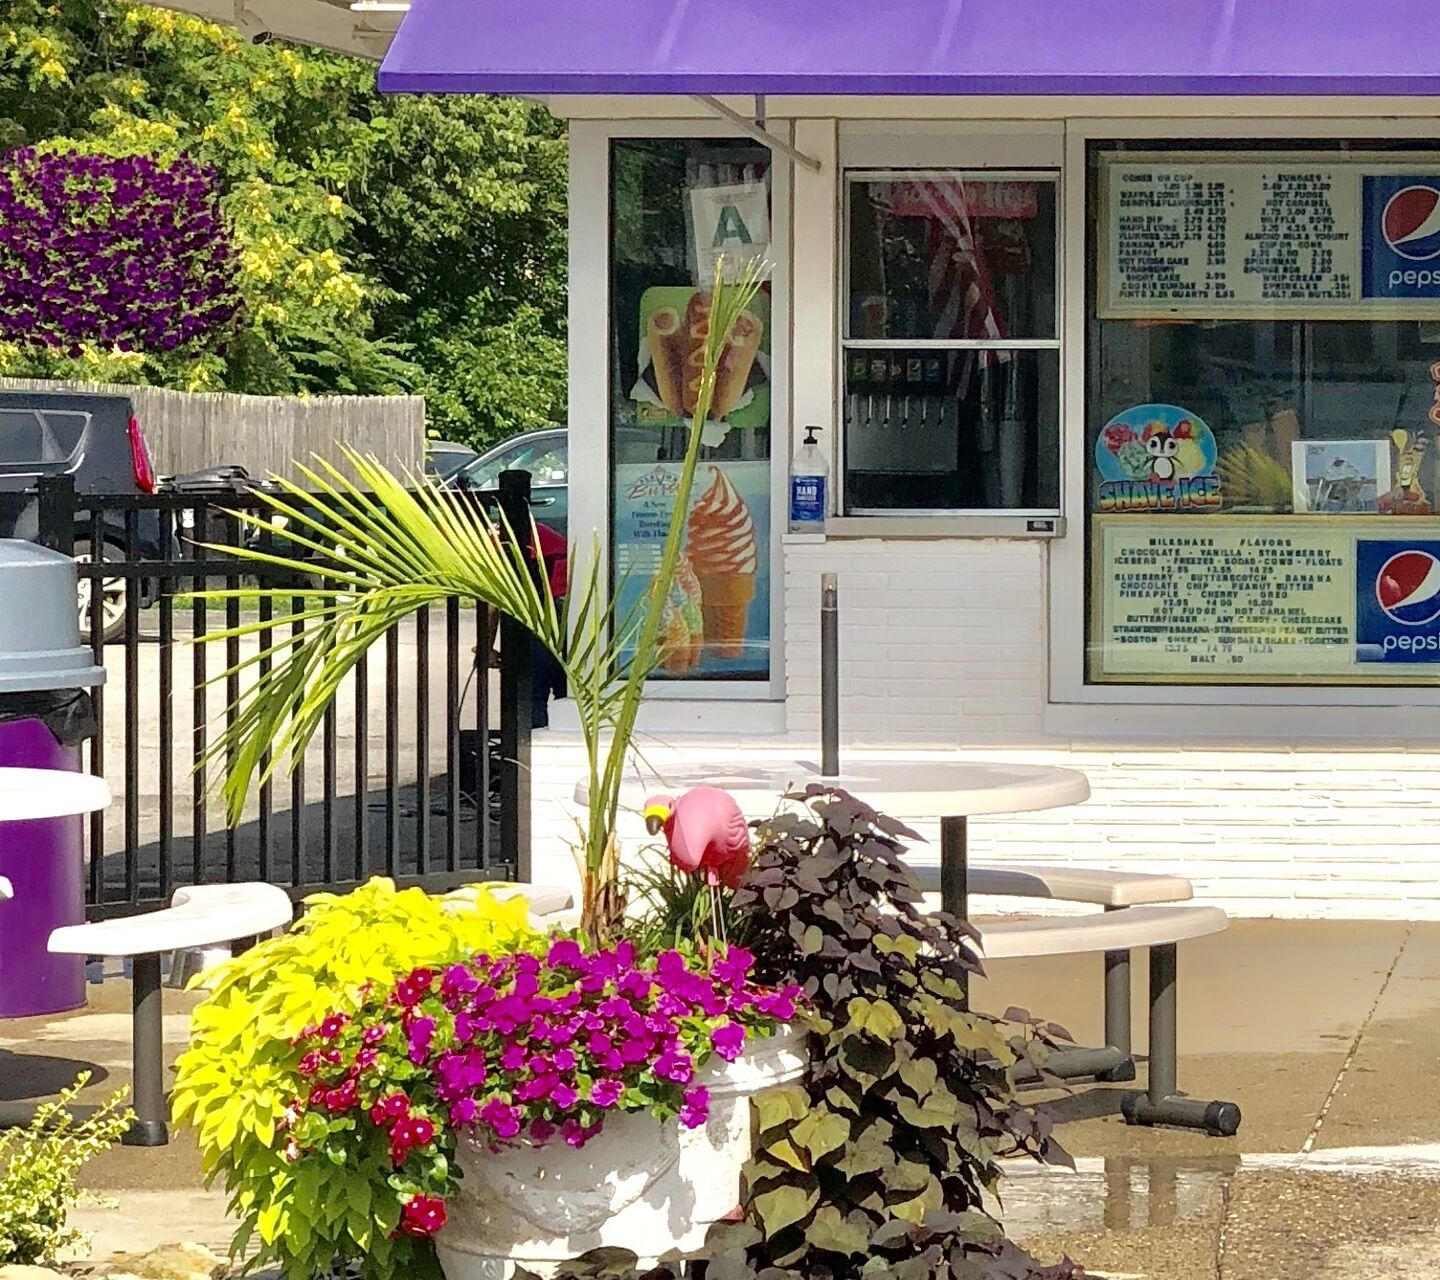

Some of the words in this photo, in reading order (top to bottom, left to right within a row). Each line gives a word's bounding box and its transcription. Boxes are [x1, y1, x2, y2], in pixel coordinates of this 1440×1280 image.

[712, 206, 753, 248] A
[1099, 480, 1176, 511] SHAVE
[1178, 476, 1222, 508] ICE
[1149, 538, 1214, 546] MILKSHAKE
[1240, 539, 1292, 547] FLAVORS
[1200, 549, 1242, 557] VANILLA
[1258, 549, 1331, 557] STRAWBERRY
[1306, 558, 1343, 566] FLOATS
[1191, 574, 1267, 582] BUTTERSCOTCH
[1186, 582, 1209, 590] CHIP
[1119, 590, 1178, 598] PINEAPPLE
[1201, 590, 1239, 598] CHERRY
[1153, 607, 1174, 615] HOT
[1182, 607, 1217, 615] FUDGE
[1235, 607, 1254, 615] HOT
[1260, 608, 1306, 616] CARAMEL
[1126, 615, 1198, 623] BUTTERFINGER
[1238, 616, 1270, 624] CANDY
[1281, 616, 1343, 624] CHEESECAKE
[1191, 655, 1216, 663] MALT
